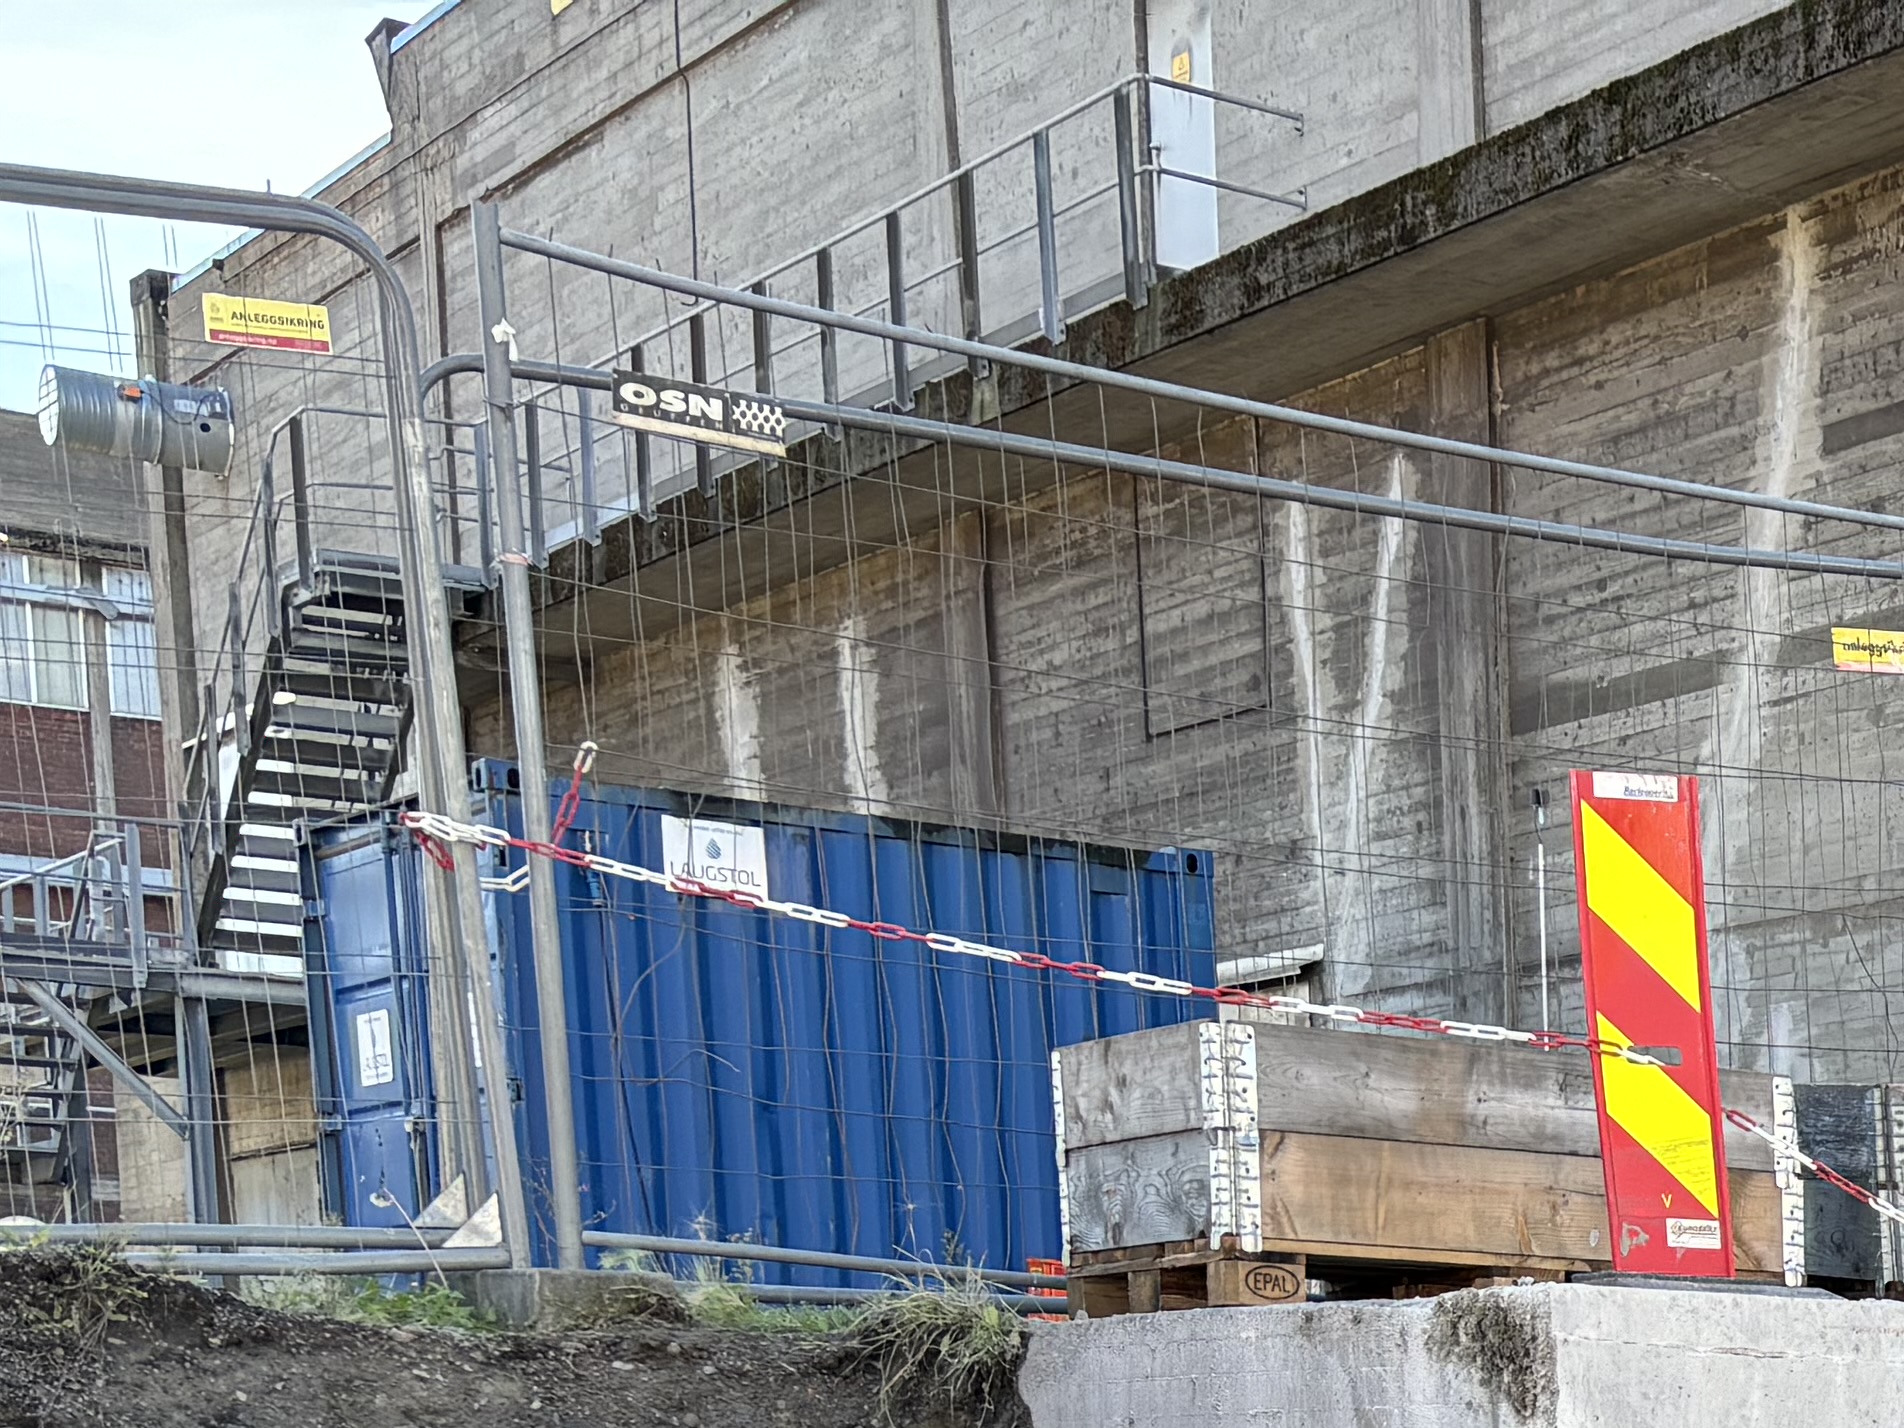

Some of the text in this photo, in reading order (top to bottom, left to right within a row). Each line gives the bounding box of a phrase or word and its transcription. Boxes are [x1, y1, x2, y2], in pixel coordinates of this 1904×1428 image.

[230, 311, 325, 330] ANLEGGSIKRING
[619, 382, 724, 421] OSN
[1661, 1193, 1672, 1208] V
[1253, 1272, 1291, 1294] EPAL
